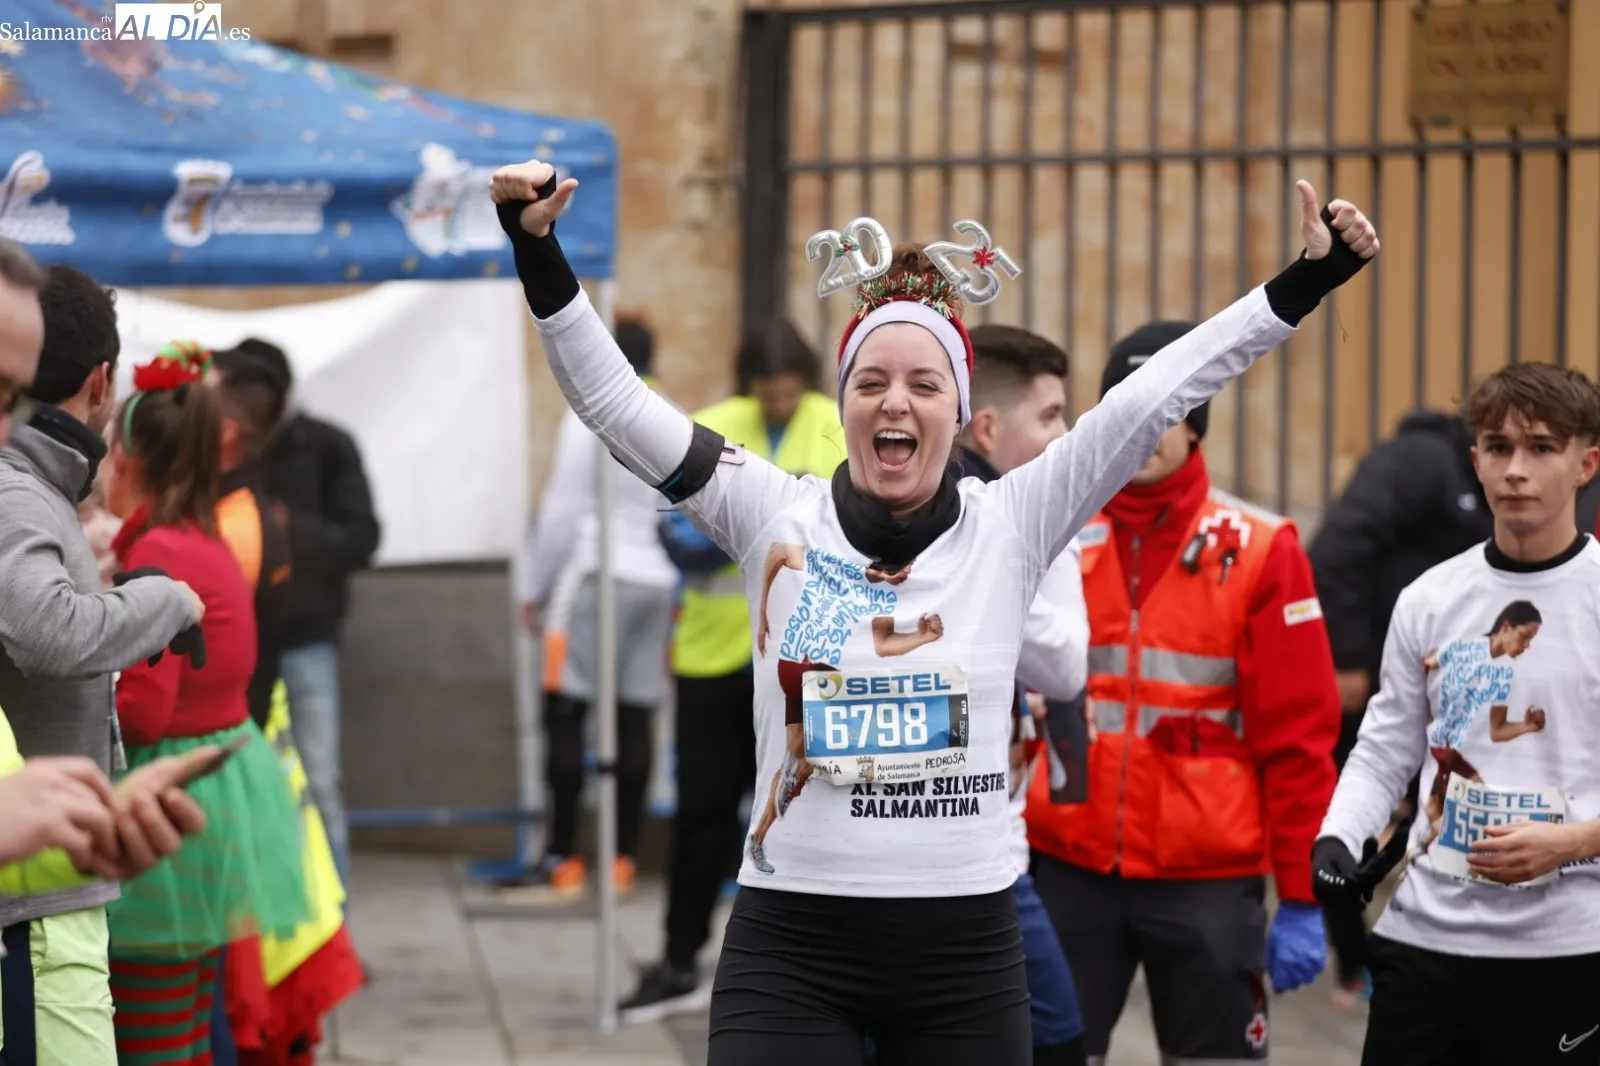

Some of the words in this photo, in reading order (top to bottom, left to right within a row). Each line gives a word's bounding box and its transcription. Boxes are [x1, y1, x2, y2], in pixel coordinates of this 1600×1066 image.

[845, 673, 952, 695] SETEL
[824, 702, 929, 750] 6798
[877, 762, 921, 772] Ayuntamiento
[925, 752, 966, 769] PEDROSA
[877, 773, 886, 781] de
[887, 772, 921, 781] Salamanca
[883, 780, 926, 796] SAN
[932, 772, 1006, 796] SILVESTRE
[850, 797, 980, 818] SALMANTINA
[1467, 788, 1551, 808] SETEL
